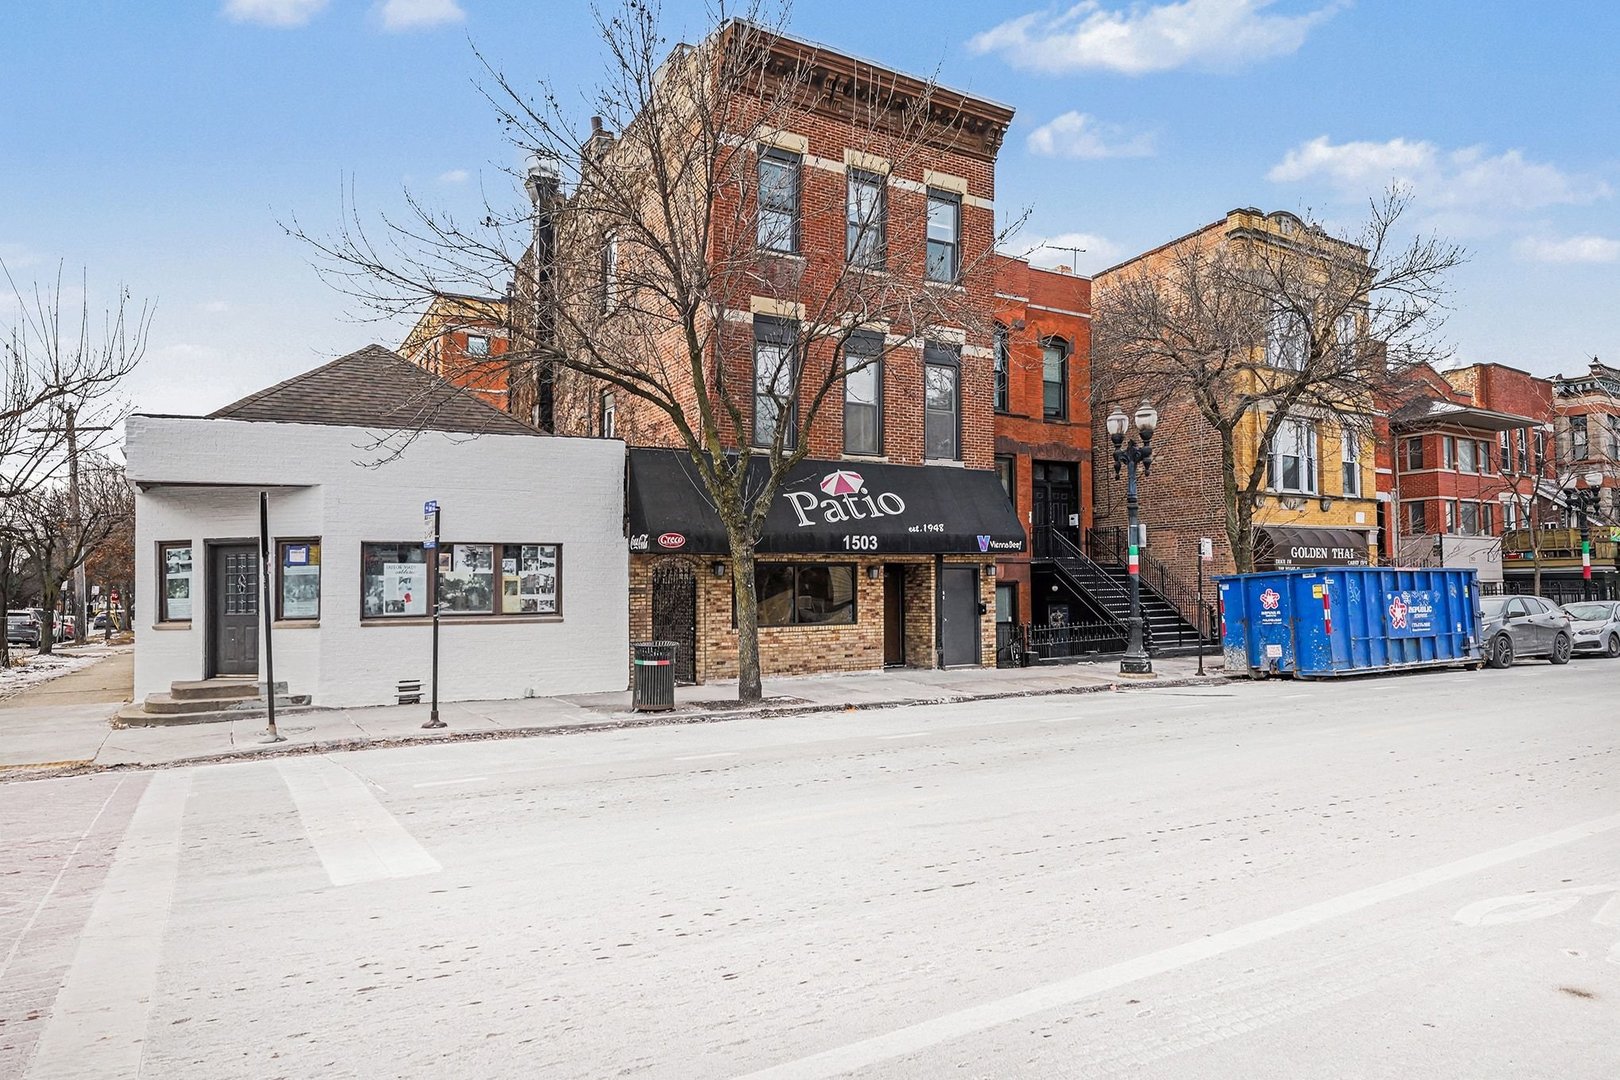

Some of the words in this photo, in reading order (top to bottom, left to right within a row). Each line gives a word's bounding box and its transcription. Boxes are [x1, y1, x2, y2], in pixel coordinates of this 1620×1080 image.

[783, 487, 906, 527] Patio
[843, 535, 878, 550] 1503
[1291, 547, 1328, 559] GOLDEN
[1331, 548, 1354, 559] THAI
